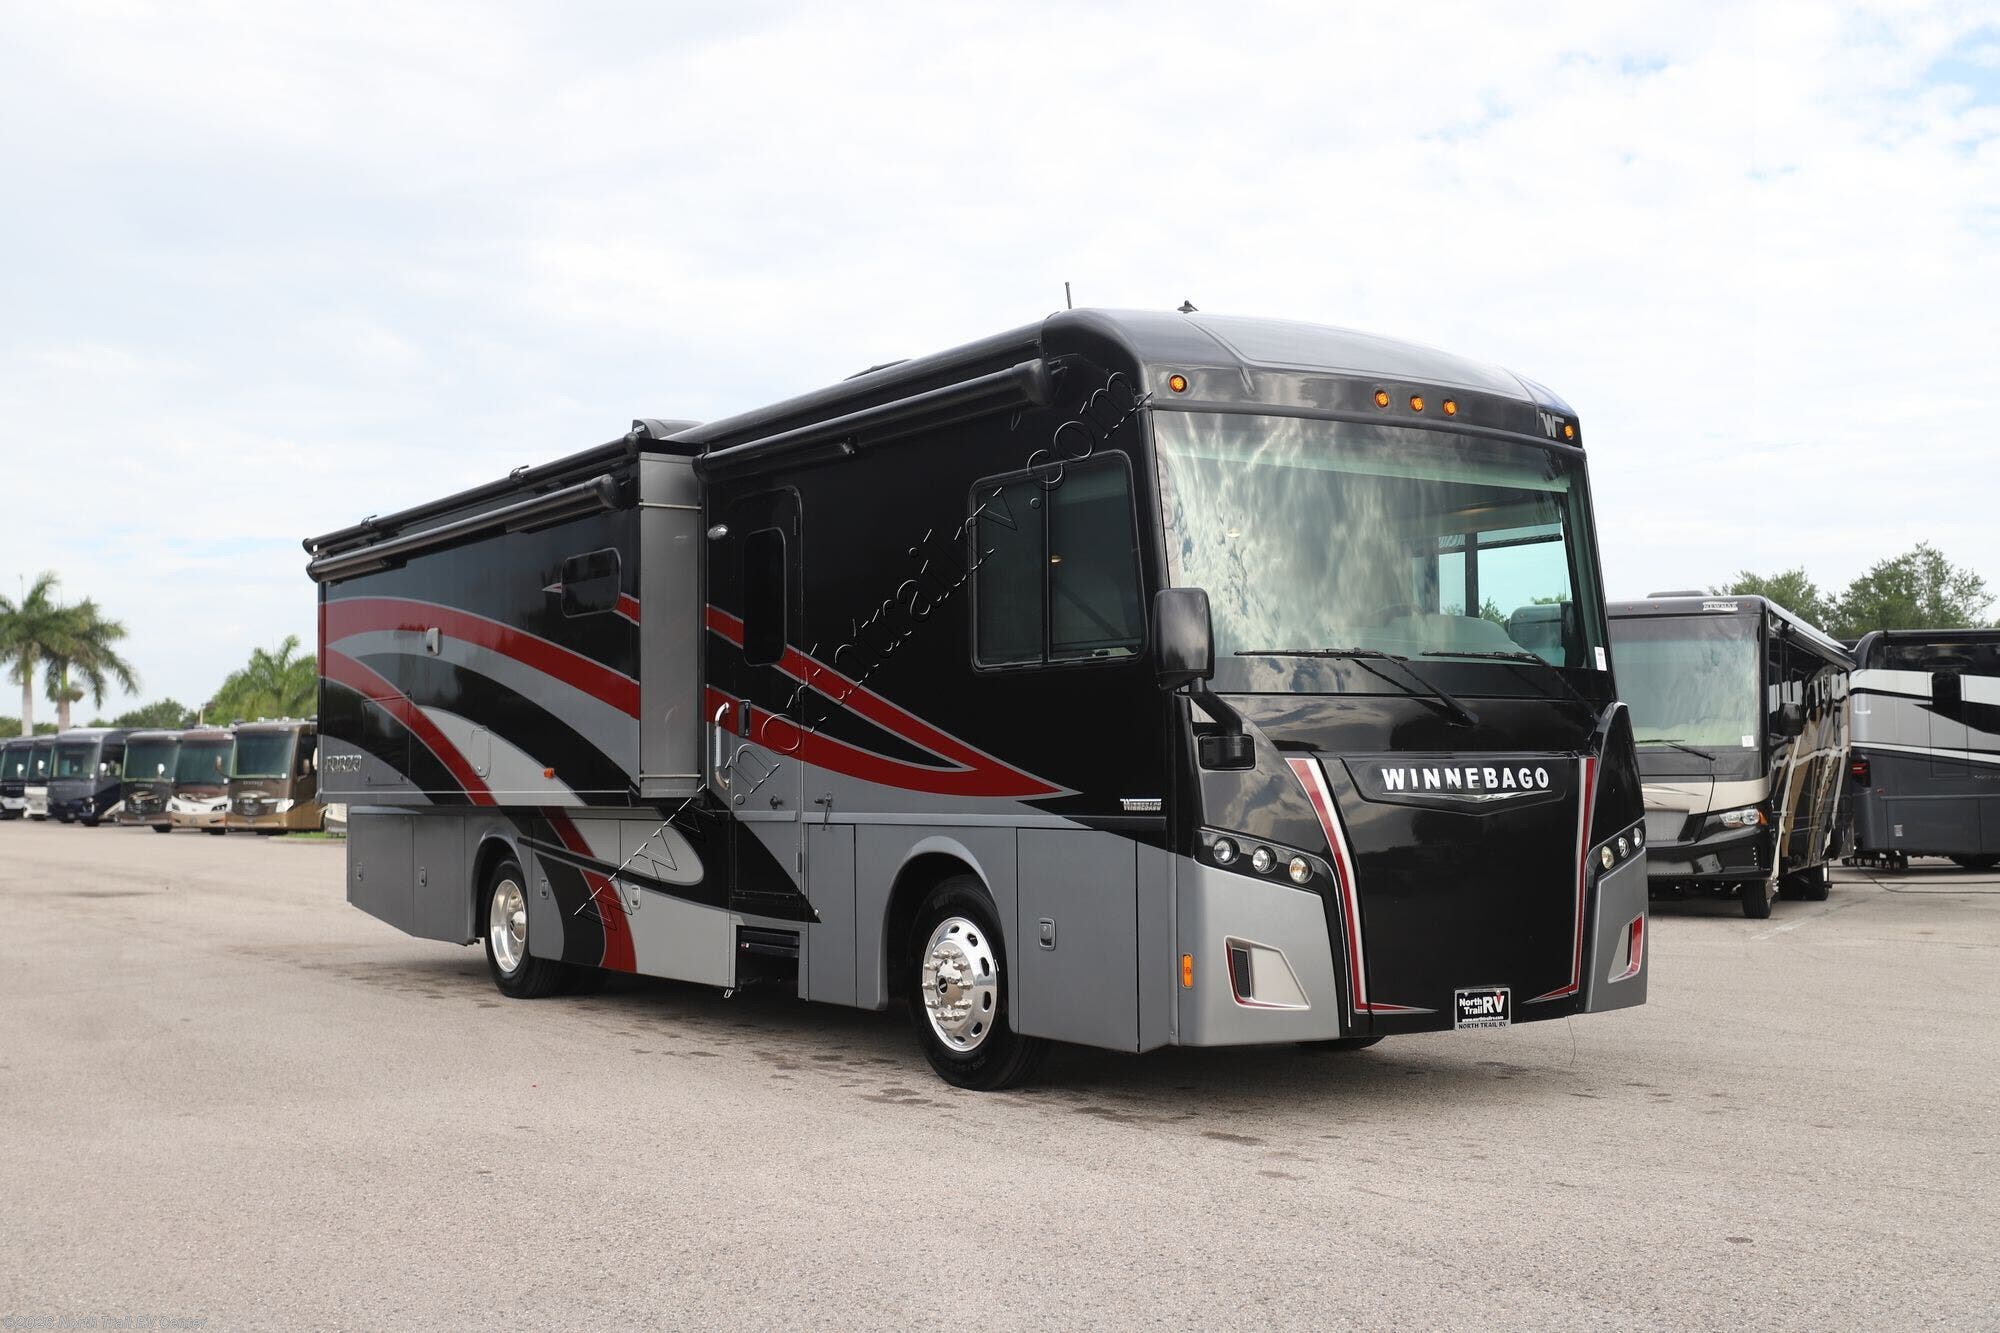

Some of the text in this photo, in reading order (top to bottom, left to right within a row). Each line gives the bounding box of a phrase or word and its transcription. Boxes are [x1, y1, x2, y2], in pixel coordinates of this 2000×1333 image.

[1382, 767, 1549, 790] WINNEBAGO
[1459, 997, 1483, 1006] North
[1482, 995, 1505, 1014] RV
[1464, 1006, 1483, 1015] Trail
